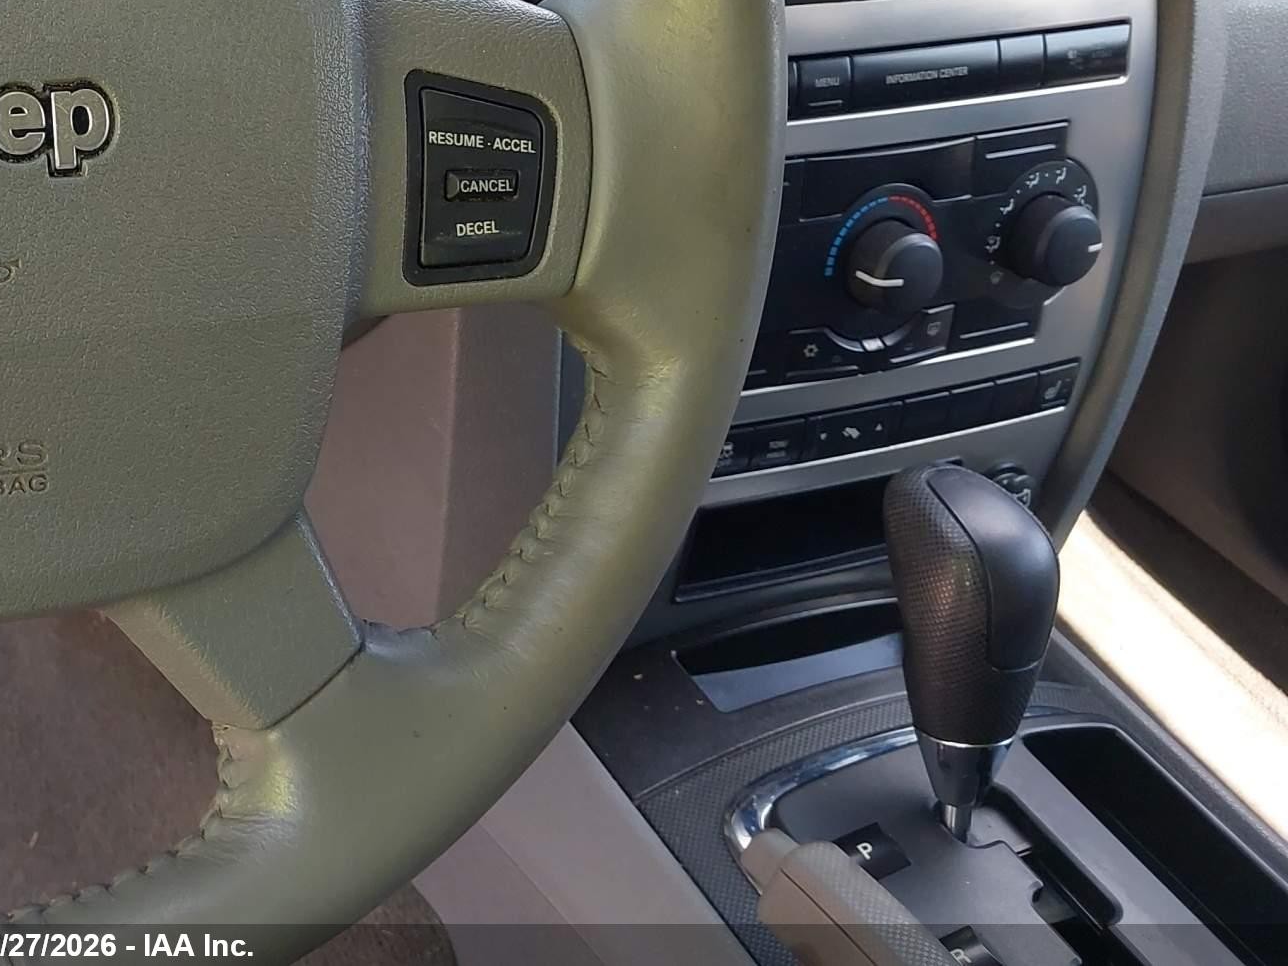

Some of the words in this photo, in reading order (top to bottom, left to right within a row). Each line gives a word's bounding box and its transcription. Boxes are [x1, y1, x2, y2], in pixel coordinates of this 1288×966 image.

[815, 77, 840, 88] MENU
[885, 68, 938, 85] INFORMATION
[939, 66, 969, 79] CENTER
[429, 131, 484, 149] RESUME
[492, 138, 537, 154] ACCEL
[460, 179, 514, 193] CANCEL
[456, 220, 500, 237] DECEL
[856, 842, 873, 860] P
